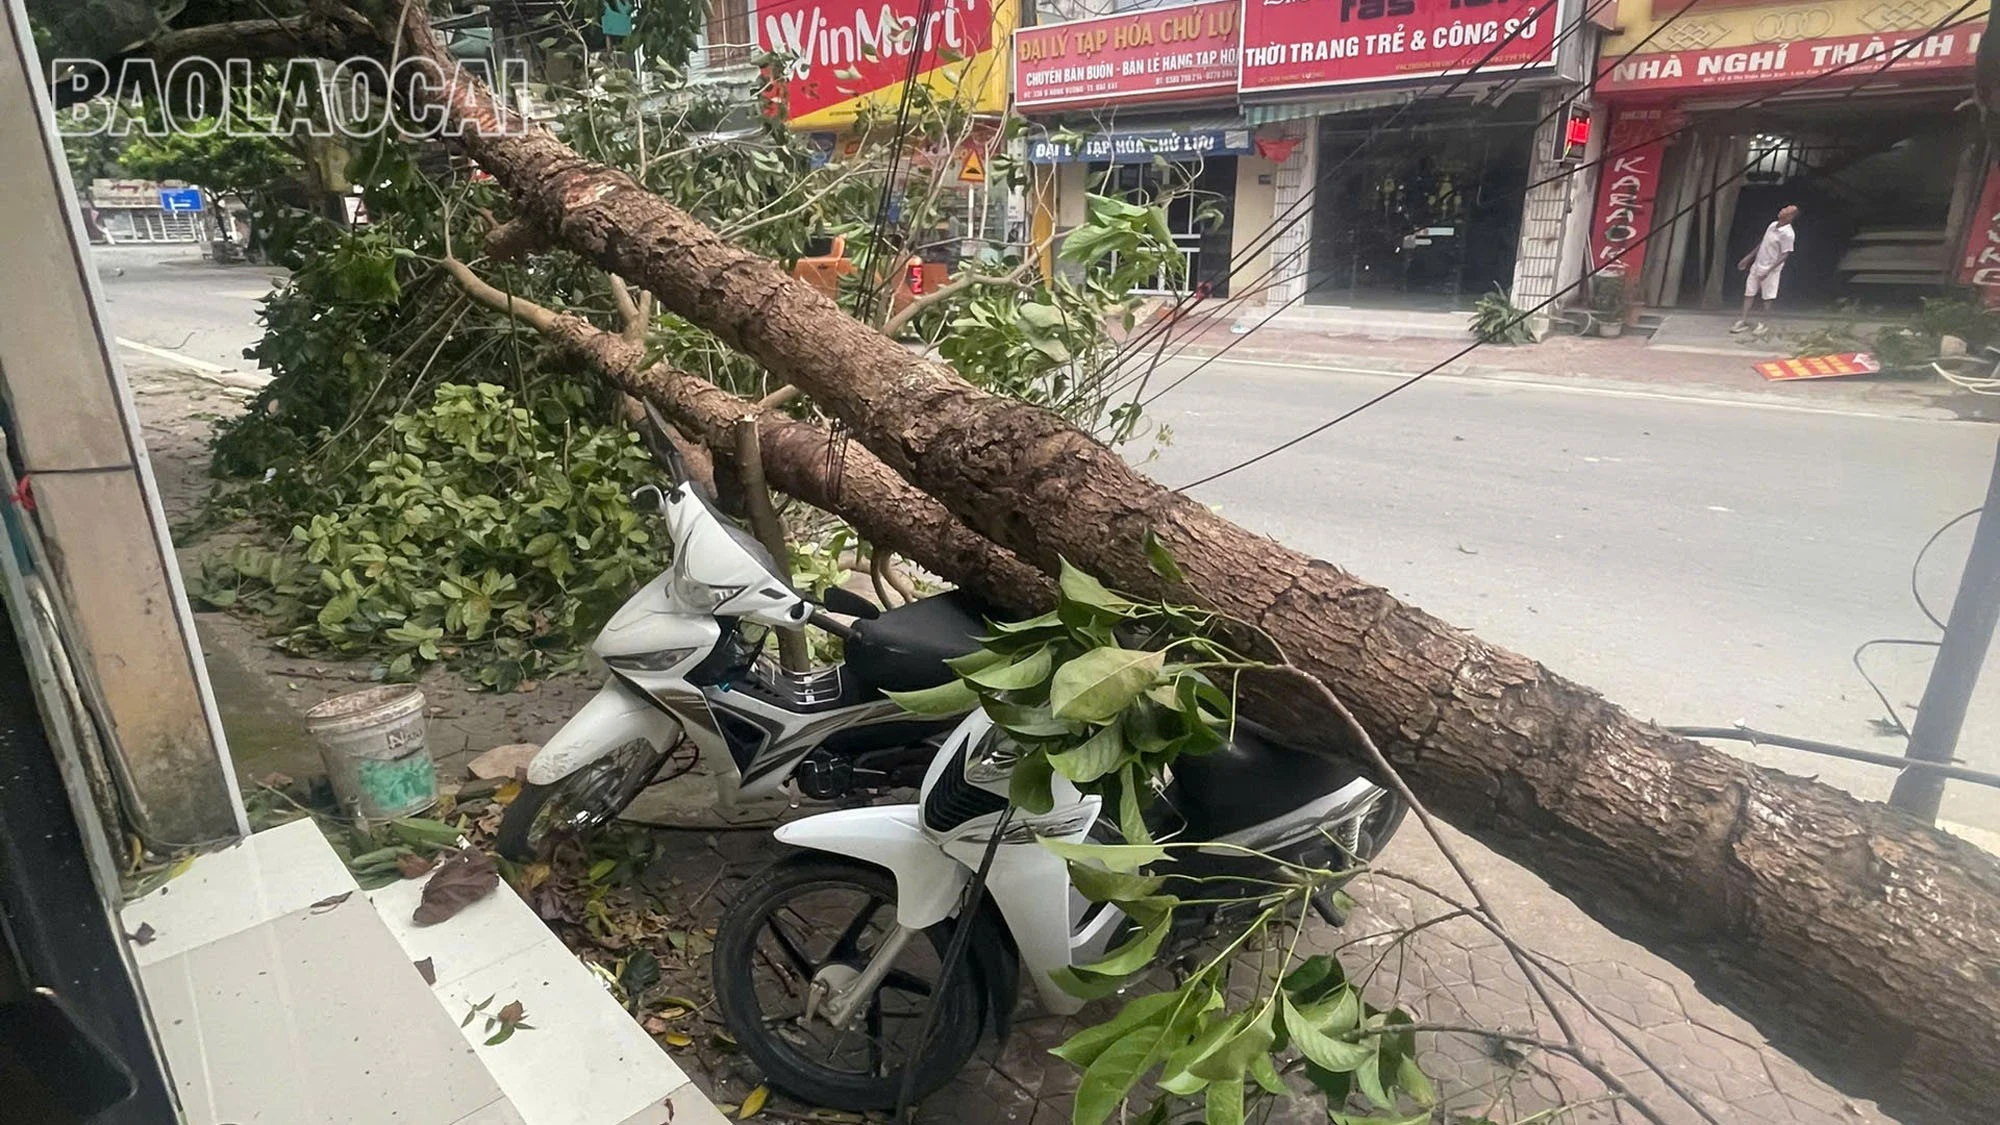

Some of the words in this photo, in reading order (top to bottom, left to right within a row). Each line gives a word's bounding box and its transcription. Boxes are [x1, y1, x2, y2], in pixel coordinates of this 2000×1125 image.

[1051, 28, 1070, 57] LÝ
[1074, 31, 1107, 58] TẠP
[1113, 16, 1154, 50] HÓA
[1208, 5, 1239, 41] LỰ
[1246, 41, 1287, 67] THỜI
[1290, 38, 1359, 63] TRANG
[1365, 23, 1407, 56] TRẺ
[1410, 30, 1427, 51] &
[1432, 20, 1498, 49] CÔNG
[1026, 64, 1062, 87] CHUYÊN
[1087, 61, 1114, 80] BUÔN
[1612, 54, 1684, 83] NHÀ
[1697, 43, 1787, 76] NGHỈ
[1810, 34, 1955, 67] THÀNH
